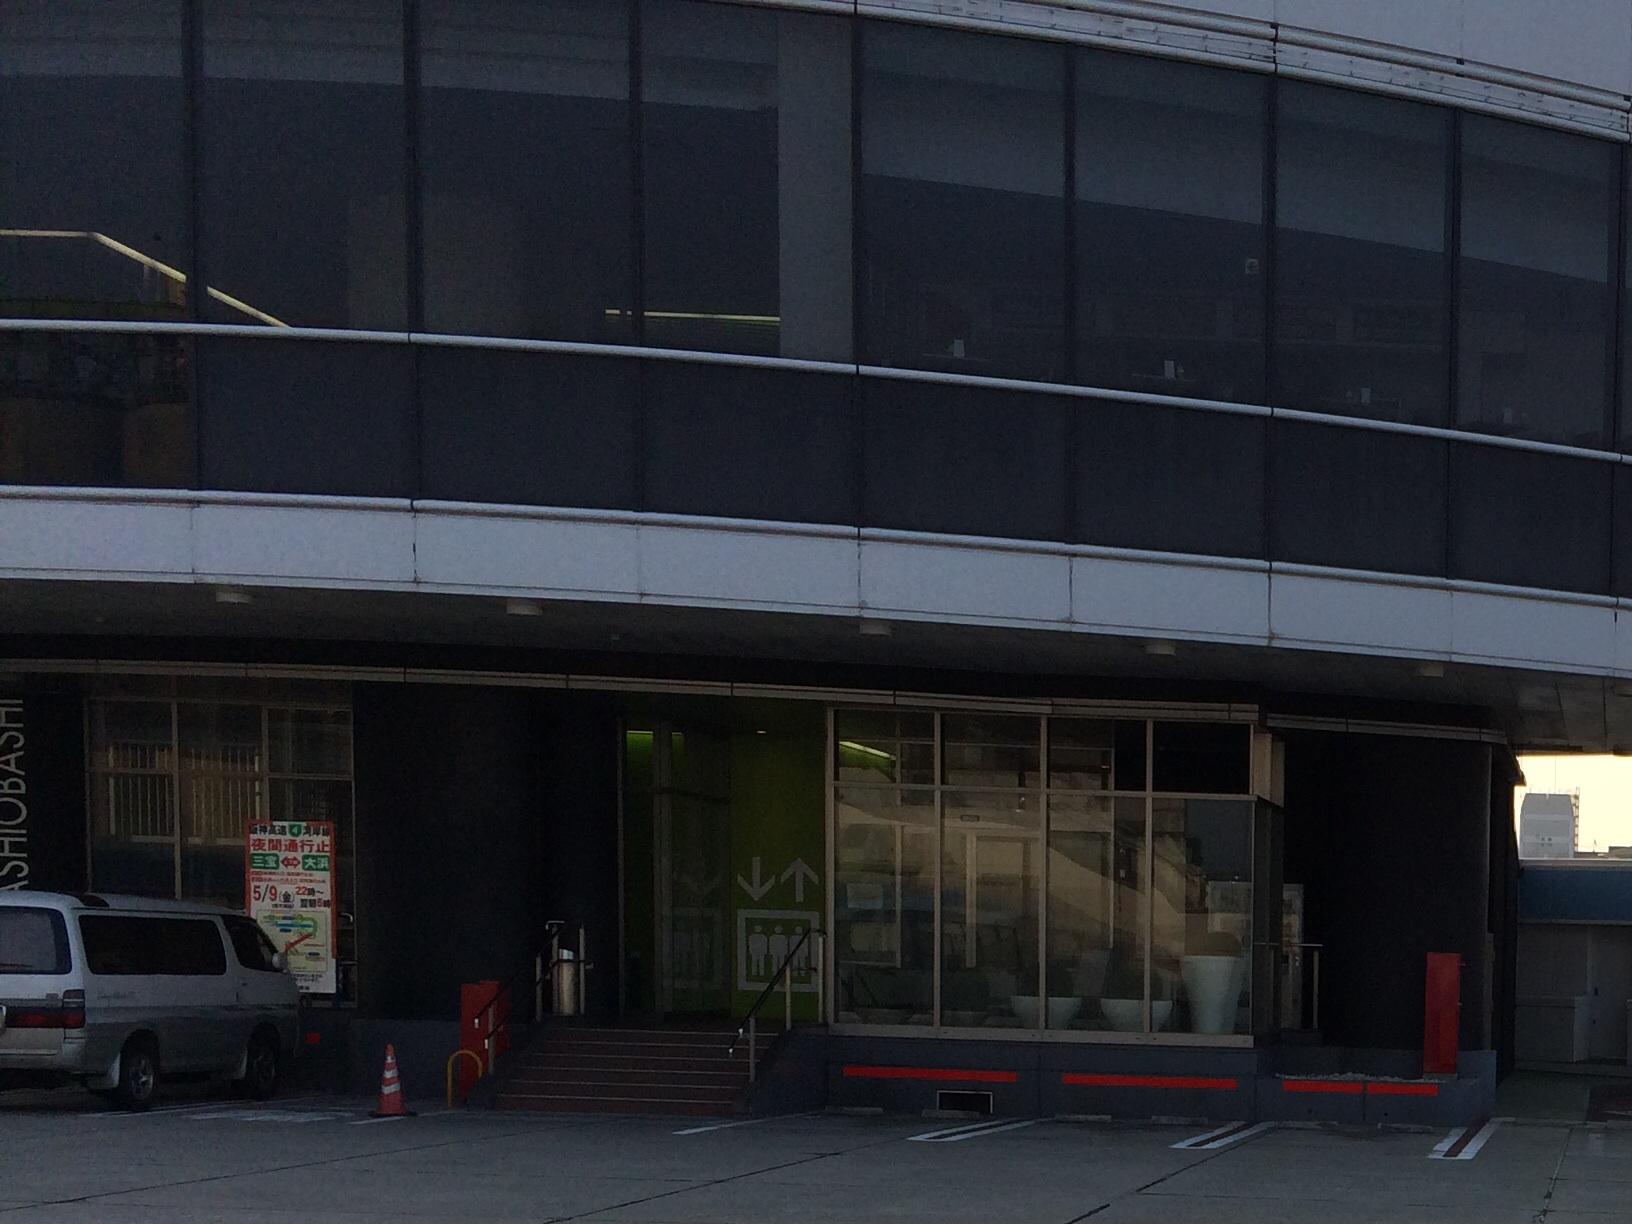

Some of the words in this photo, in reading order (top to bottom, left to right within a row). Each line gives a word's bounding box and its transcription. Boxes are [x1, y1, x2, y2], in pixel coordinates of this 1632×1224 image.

[251, 838, 330, 852] 夜間通行止
